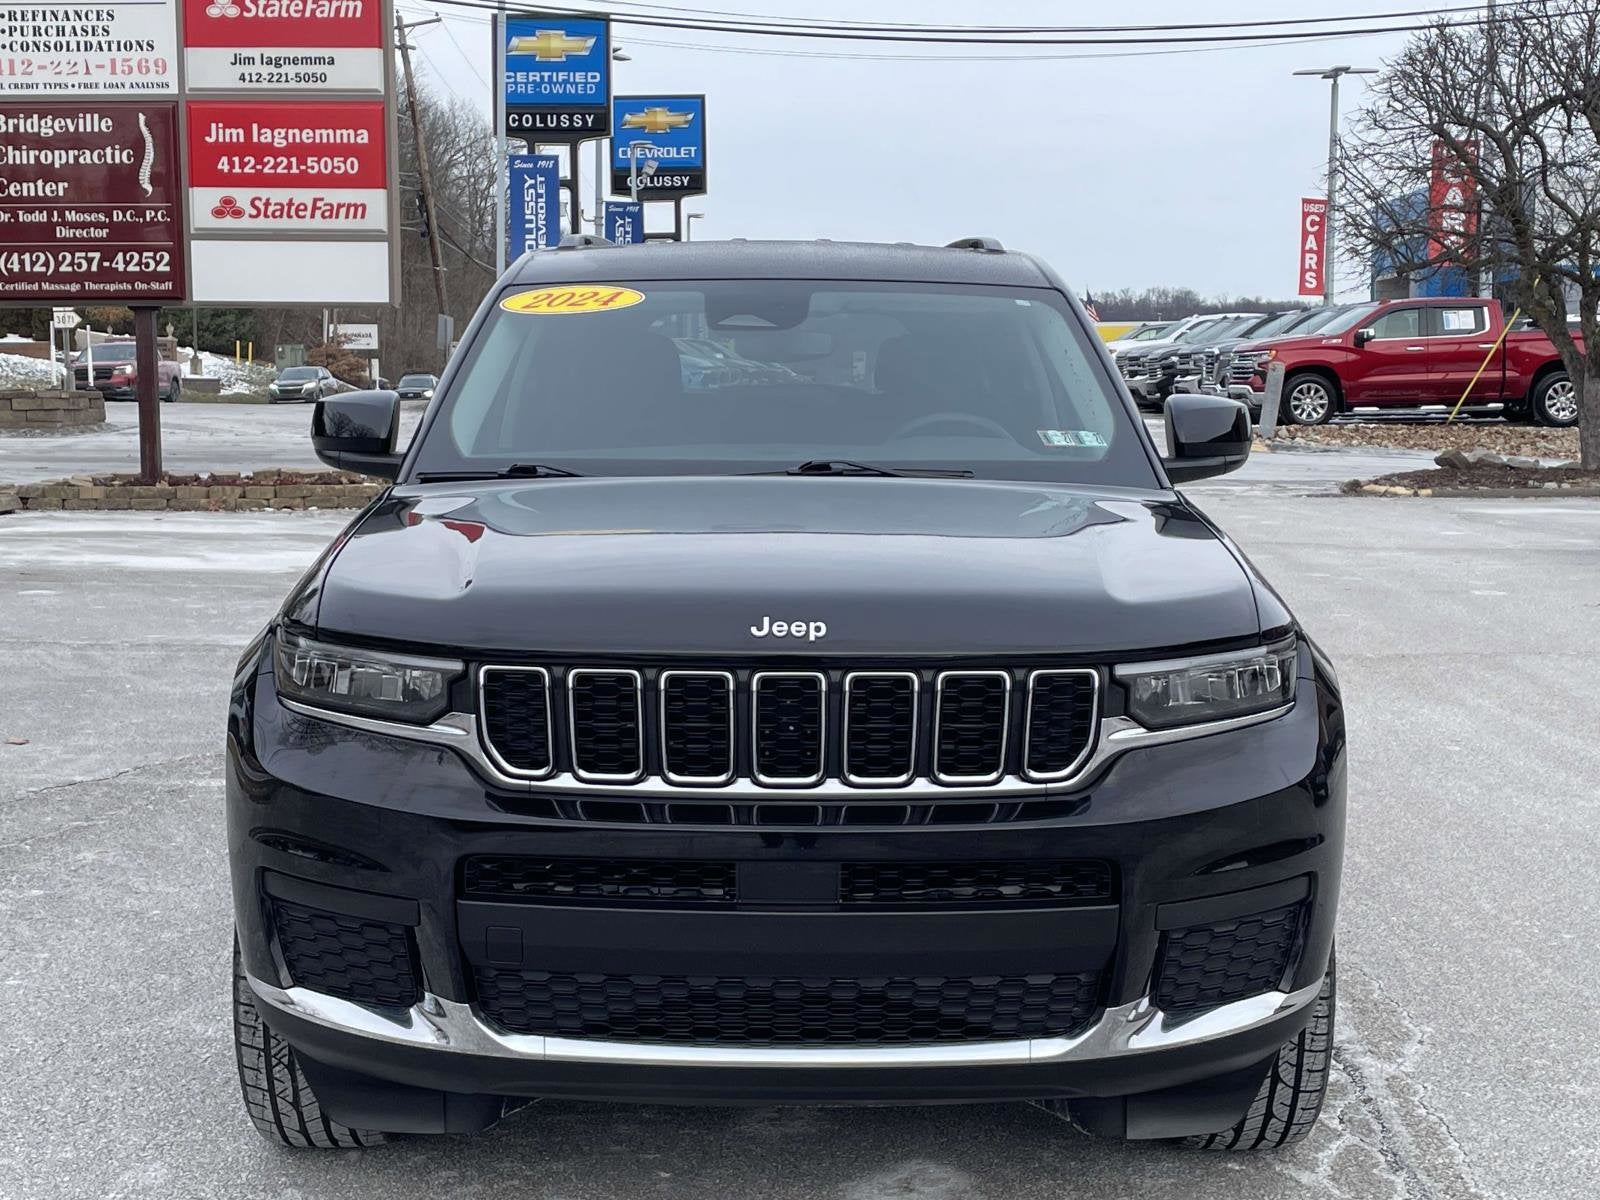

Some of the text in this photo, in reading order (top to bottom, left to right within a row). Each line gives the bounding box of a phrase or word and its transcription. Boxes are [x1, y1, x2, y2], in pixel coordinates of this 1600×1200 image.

[8, 9, 115, 22] REFINANCES
[8, 25, 110, 37] PURCHASES
[9, 40, 155, 52] CONSOLIDATIONS
[230, 53, 255, 66] Jim
[239, 72, 327, 84] 412-221-5050
[504, 72, 601, 83] CERTIFIED
[103, 82, 125, 90] LOAN
[507, 84, 596, 94] PRE-OWNED
[508, 114, 594, 127] COLUSSY
[204, 122, 369, 147] Jim Iagnemma
[217, 156, 359, 174] 412-221-5050
[514, 160, 555, 168] Since 1918
[17, 211, 48, 222] Todd
[51, 211, 61, 222] J.
[65, 211, 109, 223] Moses,
[146, 210, 171, 222] P.C.
[524, 174, 536, 253] OLUSSY
[56, 226, 109, 238] Director
[1304, 214, 1321, 289] CARS
[58, 251, 170, 272] 257-4252
[0, 281, 173, 293] Certified Massage Therapists On-Staff
[522, 291, 625, 309] 2024
[750, 616, 827, 641] Jeep
